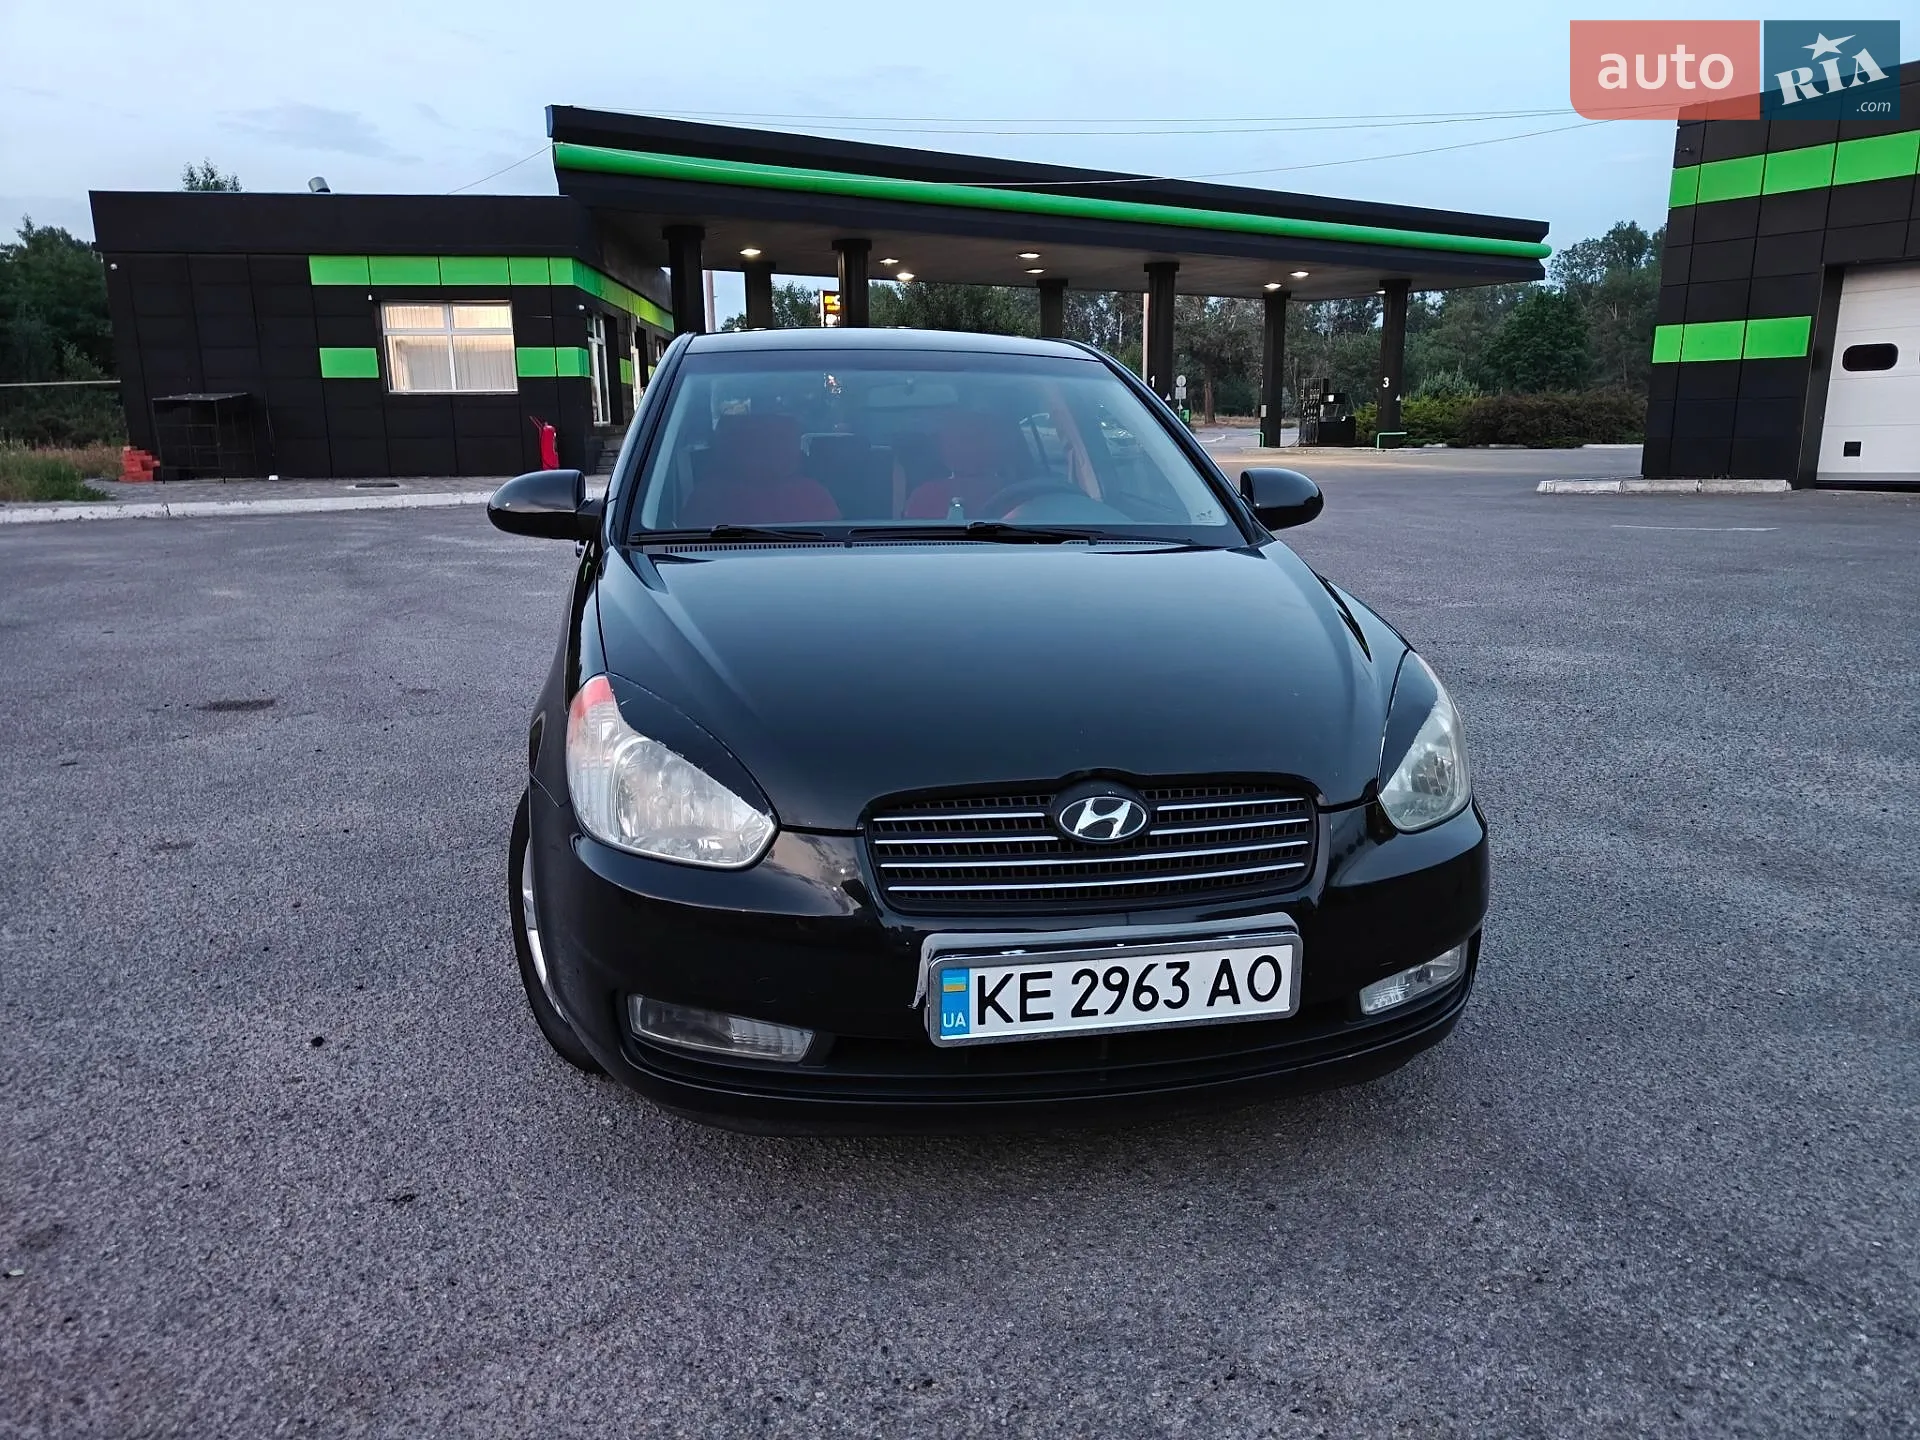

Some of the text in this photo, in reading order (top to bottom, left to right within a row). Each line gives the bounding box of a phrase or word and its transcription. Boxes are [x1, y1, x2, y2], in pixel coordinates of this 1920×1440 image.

[1150, 375, 1156, 388] 1
[1382, 377, 1390, 388] 3
[977, 954, 1282, 1026] KE 2963 AO
[943, 1012, 967, 1028] UA
